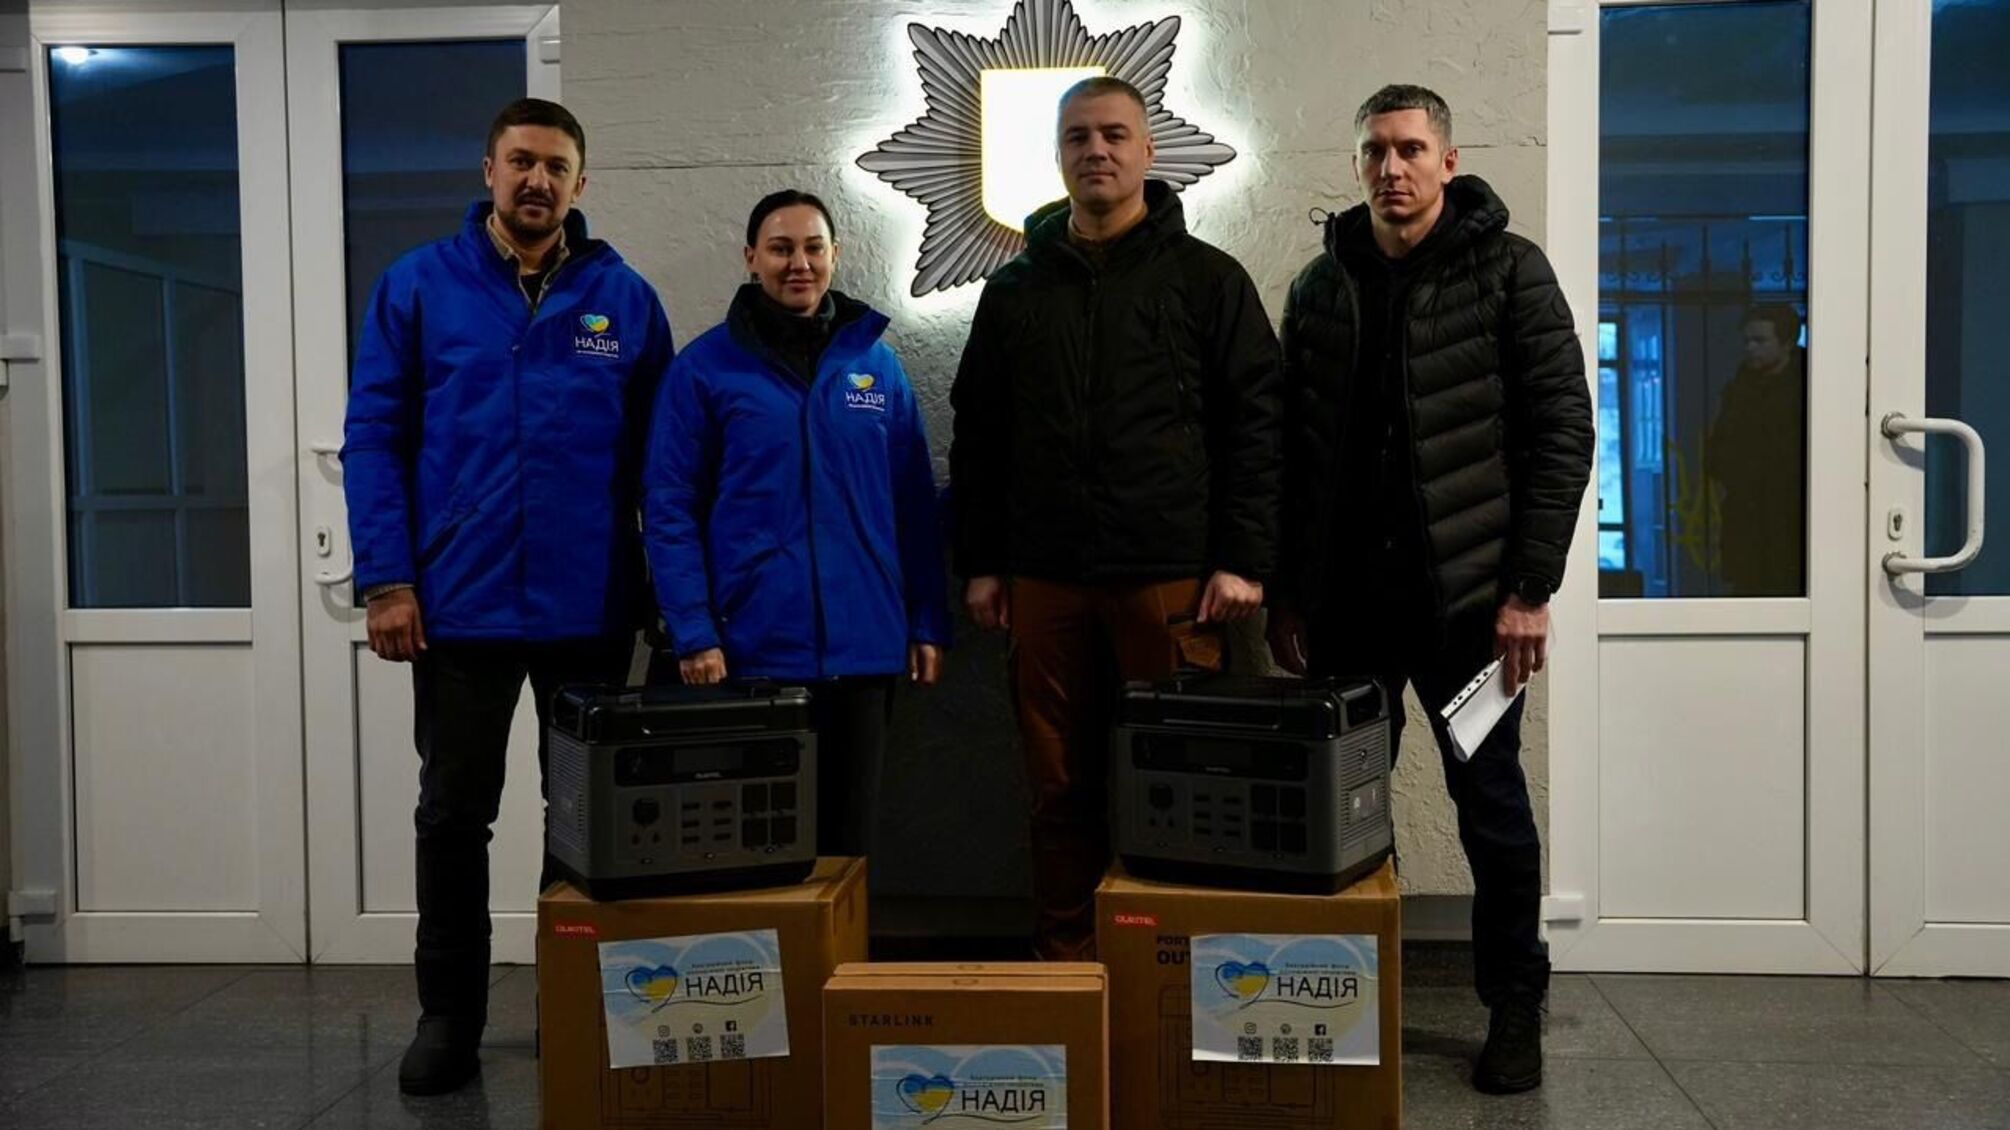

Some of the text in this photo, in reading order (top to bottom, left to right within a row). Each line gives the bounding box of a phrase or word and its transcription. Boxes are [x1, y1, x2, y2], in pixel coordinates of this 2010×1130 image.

[574, 335, 620, 353] НАДІЯ
[845, 391, 885, 407] НАДІЯ
[685, 972, 764, 997] НАДІЯ
[1277, 976, 1358, 1000] НАДІЯ
[849, 1014, 935, 1026] STARLINK
[962, 1089, 1045, 1113] НАДІЯ
